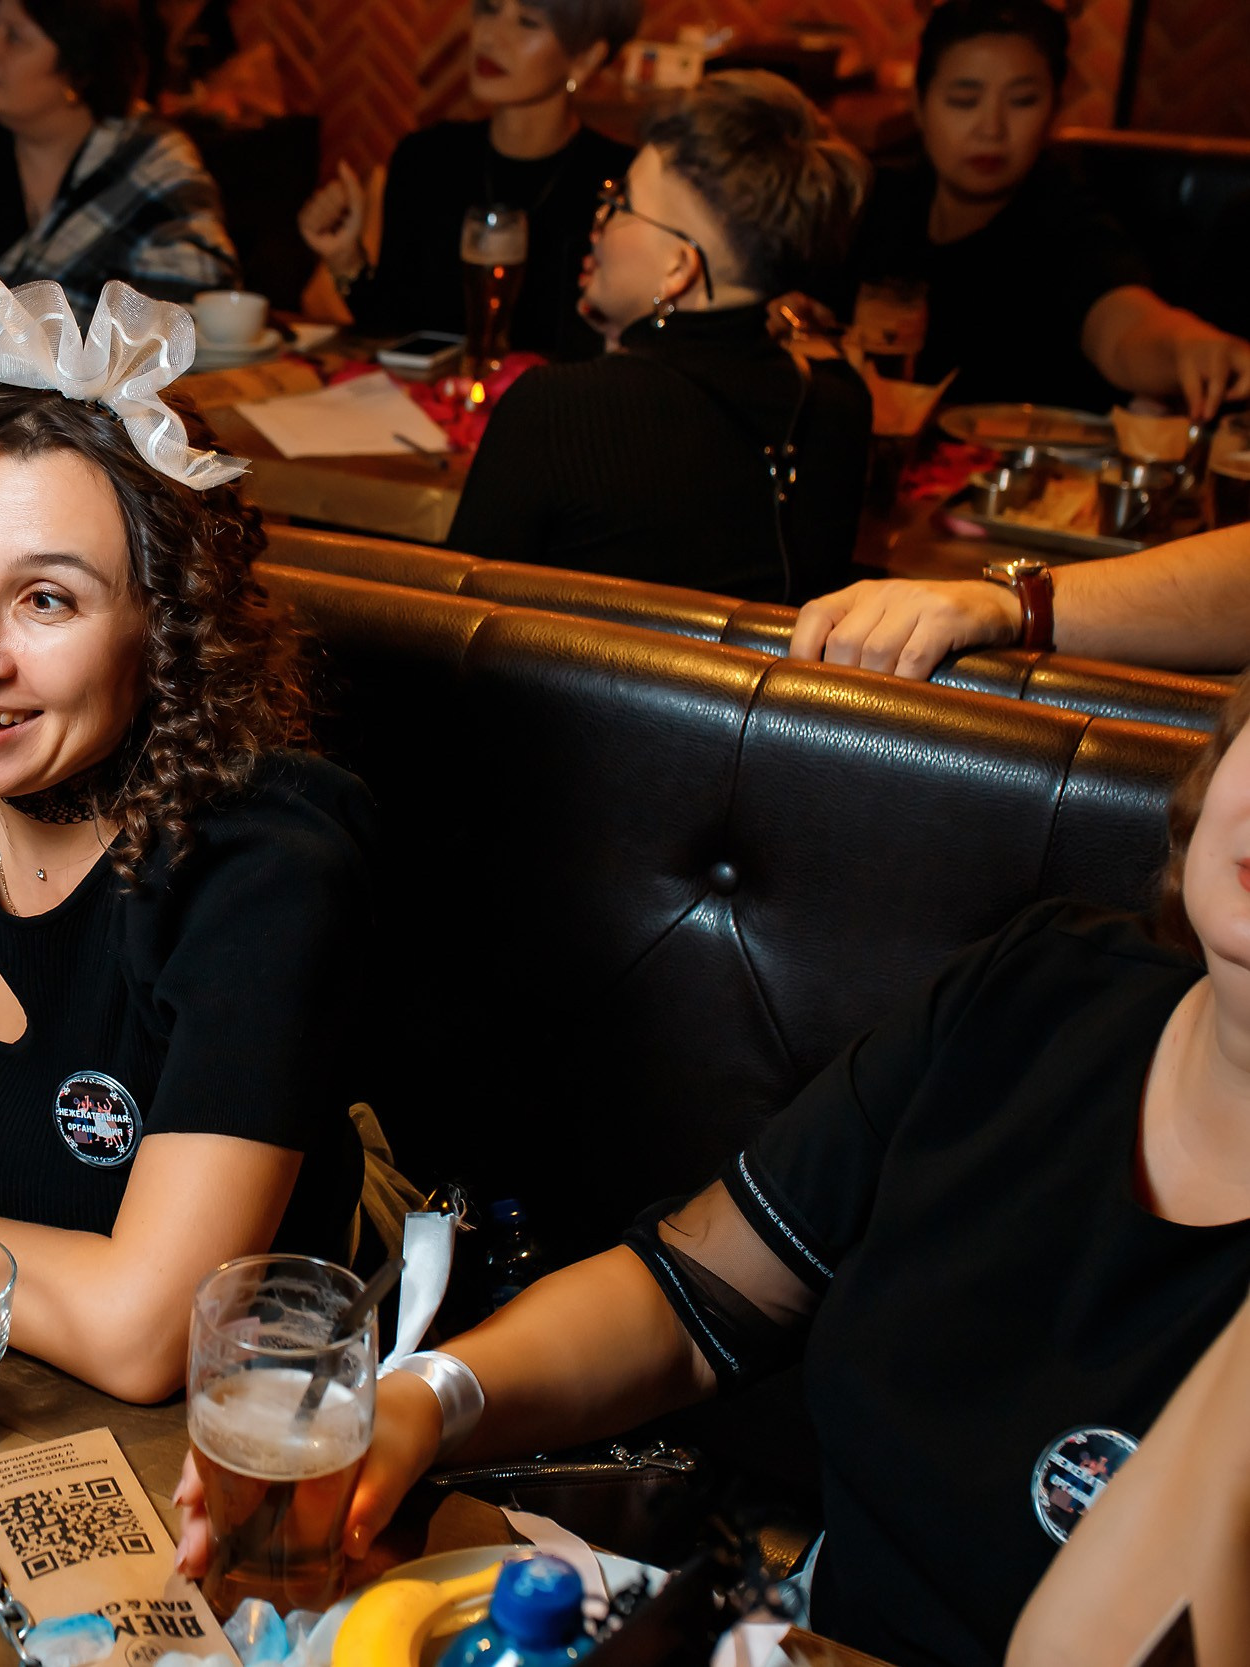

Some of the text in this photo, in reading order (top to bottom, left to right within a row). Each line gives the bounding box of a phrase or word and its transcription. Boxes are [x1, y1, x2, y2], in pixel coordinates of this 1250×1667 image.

[756, 1193, 770, 1208] NICE
[766, 1206, 781, 1223] NICE
[777, 1221, 793, 1238] NICE
[790, 1235, 806, 1252] NICE
[803, 1249, 819, 1265] NICE
[146, 1600, 193, 1612] BAR
[114, 1614, 206, 1643] BREM
